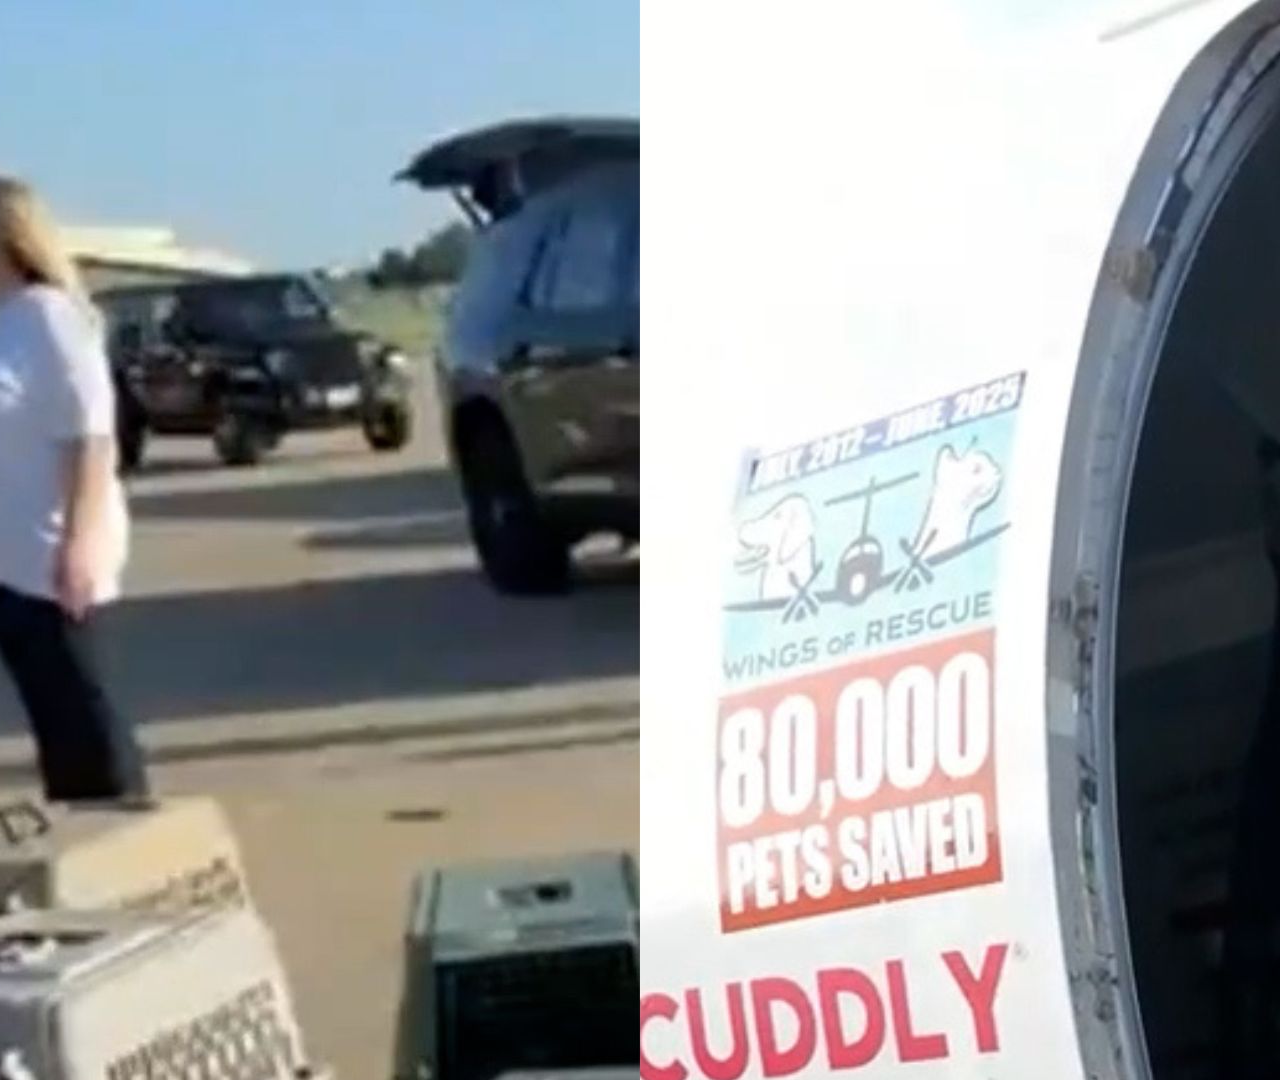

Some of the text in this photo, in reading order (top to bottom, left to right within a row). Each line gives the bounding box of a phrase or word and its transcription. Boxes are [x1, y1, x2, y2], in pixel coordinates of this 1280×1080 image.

[806, 428, 865, 473] 2012
[950, 379, 1020, 424] 2025
[723, 591, 992, 680] WINGS OF RESCUE
[720, 651, 990, 828] 80,000
[727, 793, 989, 916] PETS SAVED
